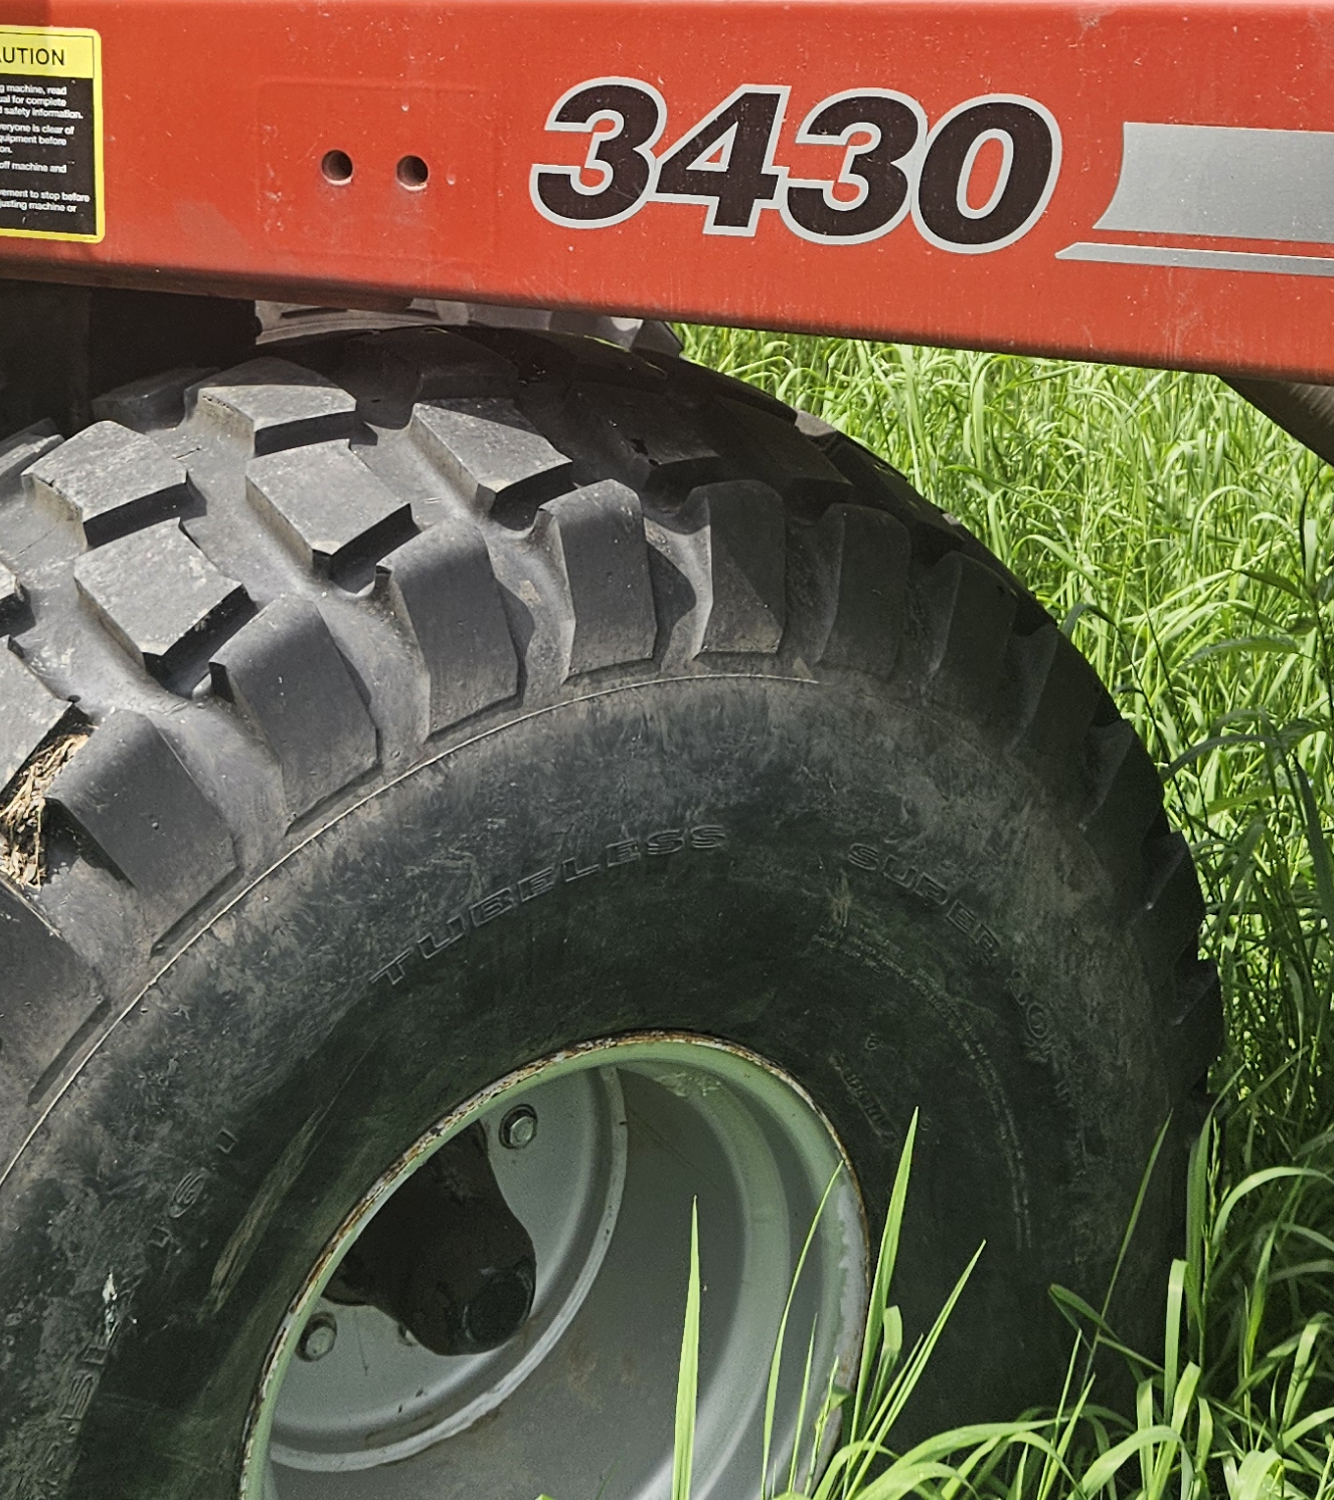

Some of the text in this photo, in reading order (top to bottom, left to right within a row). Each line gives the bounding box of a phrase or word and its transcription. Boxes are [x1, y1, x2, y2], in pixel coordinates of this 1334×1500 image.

[6, 83, 45, 95] machine,
[46, 86, 66, 95] read
[11, 96, 24, 104] for
[25, 96, 66, 107] complete
[4, 106, 30, 117] safety
[32, 108, 83, 118] information.
[32, 124, 39, 132] is
[41, 124, 63, 133] clear
[64, 126, 74, 134] of
[38, 136, 66, 145] before
[11, 161, 47, 171] machine
[49, 163, 66, 172] and
[528, 76, 1063, 254] 3430
[29, 189, 39, 198] to
[40, 190, 60, 201] stop
[61, 191, 90, 201] before
[28, 201, 65, 211] machine
[369, 824, 727, 986] TUBELESS
